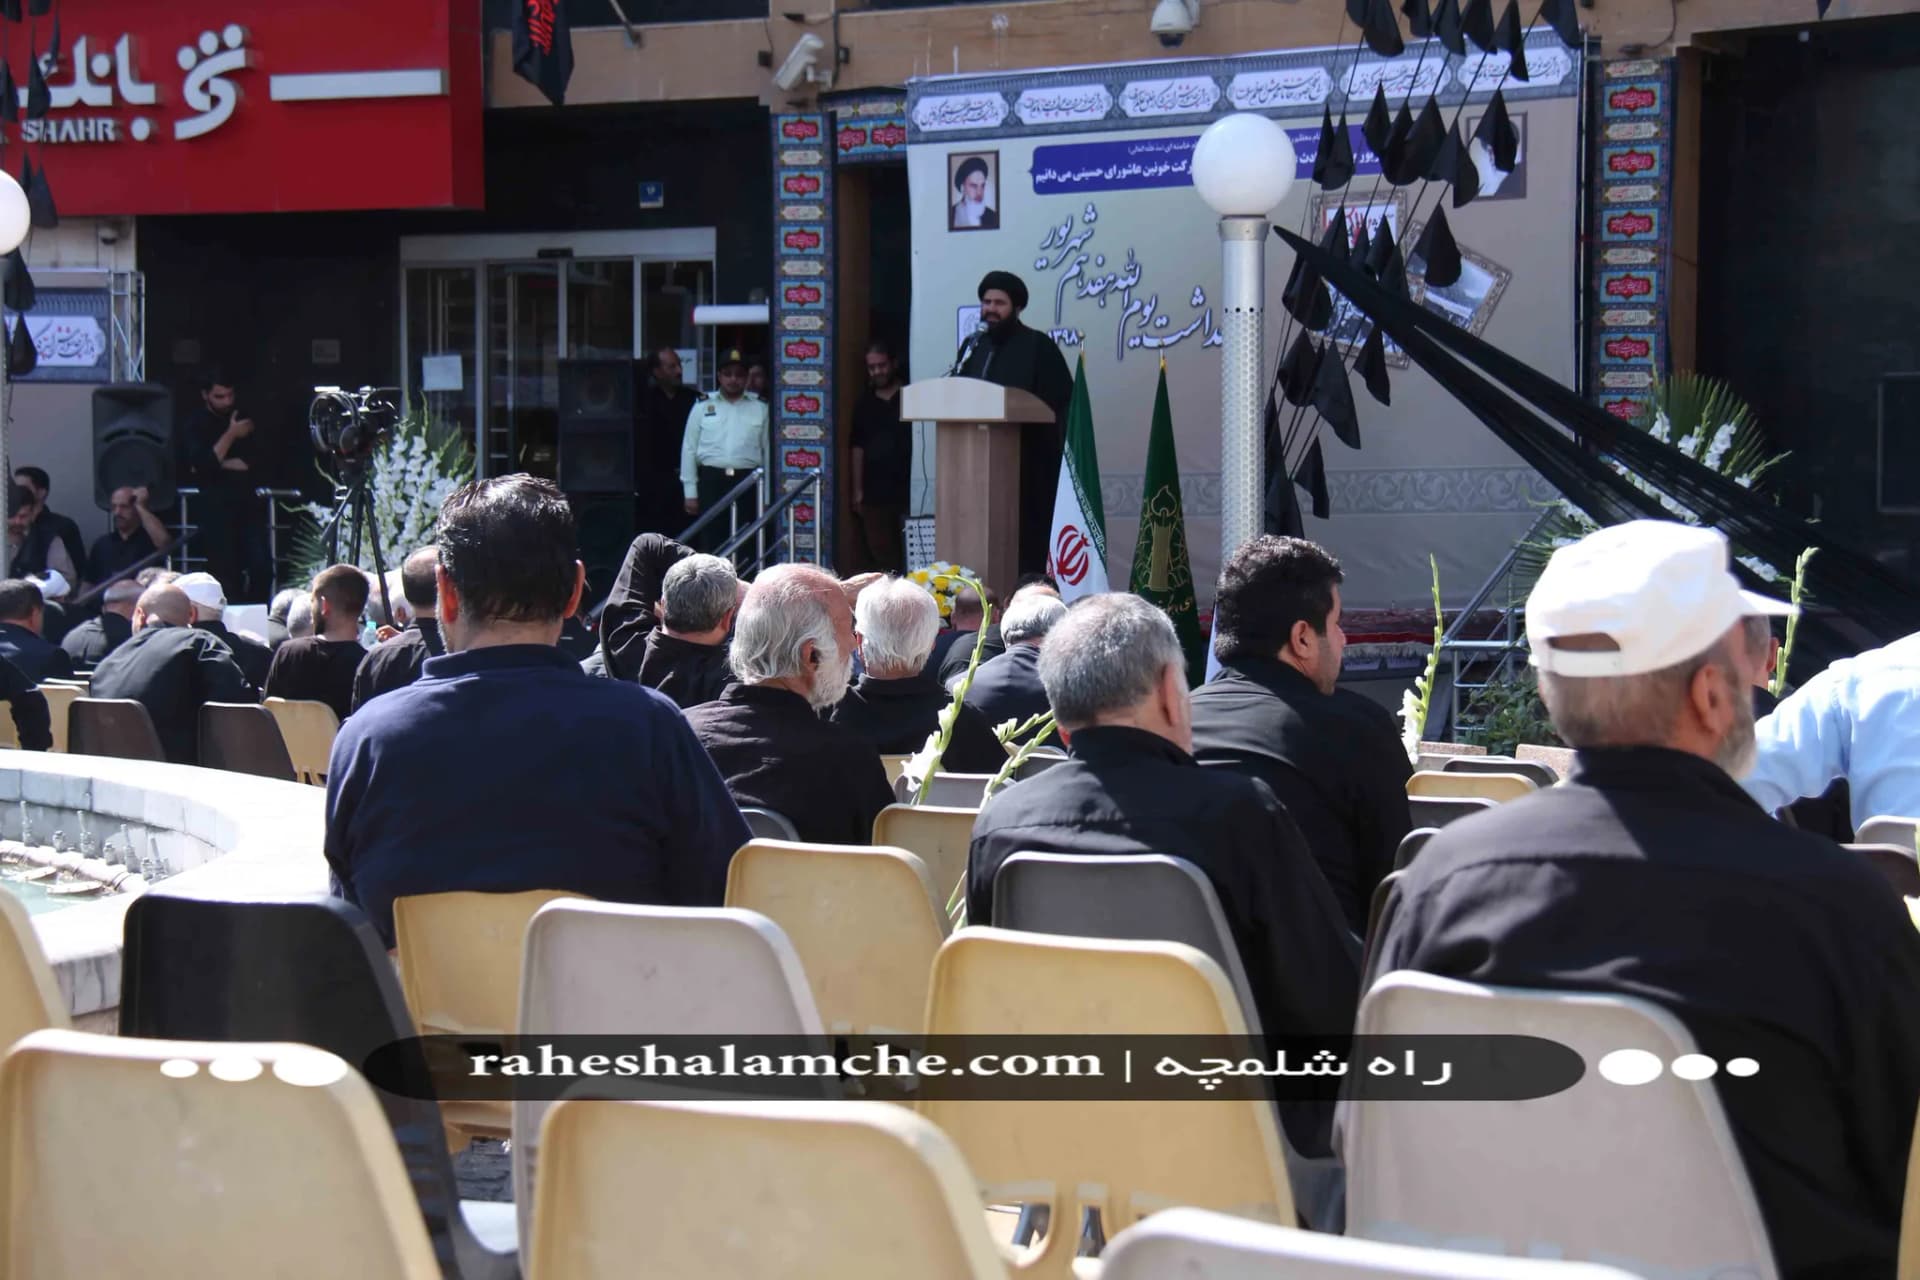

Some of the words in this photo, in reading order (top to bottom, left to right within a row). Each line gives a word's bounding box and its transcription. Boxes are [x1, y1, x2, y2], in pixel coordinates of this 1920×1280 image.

[21, 117, 115, 143] SHAHR
[1072, 167, 1103, 182] حسینی
[1104, 163, 1142, 180] عاشورای
[1143, 161, 1170, 177] خونین
[1172, 159, 1193, 176] رکت
[1035, 203, 1097, 269] شهریور
